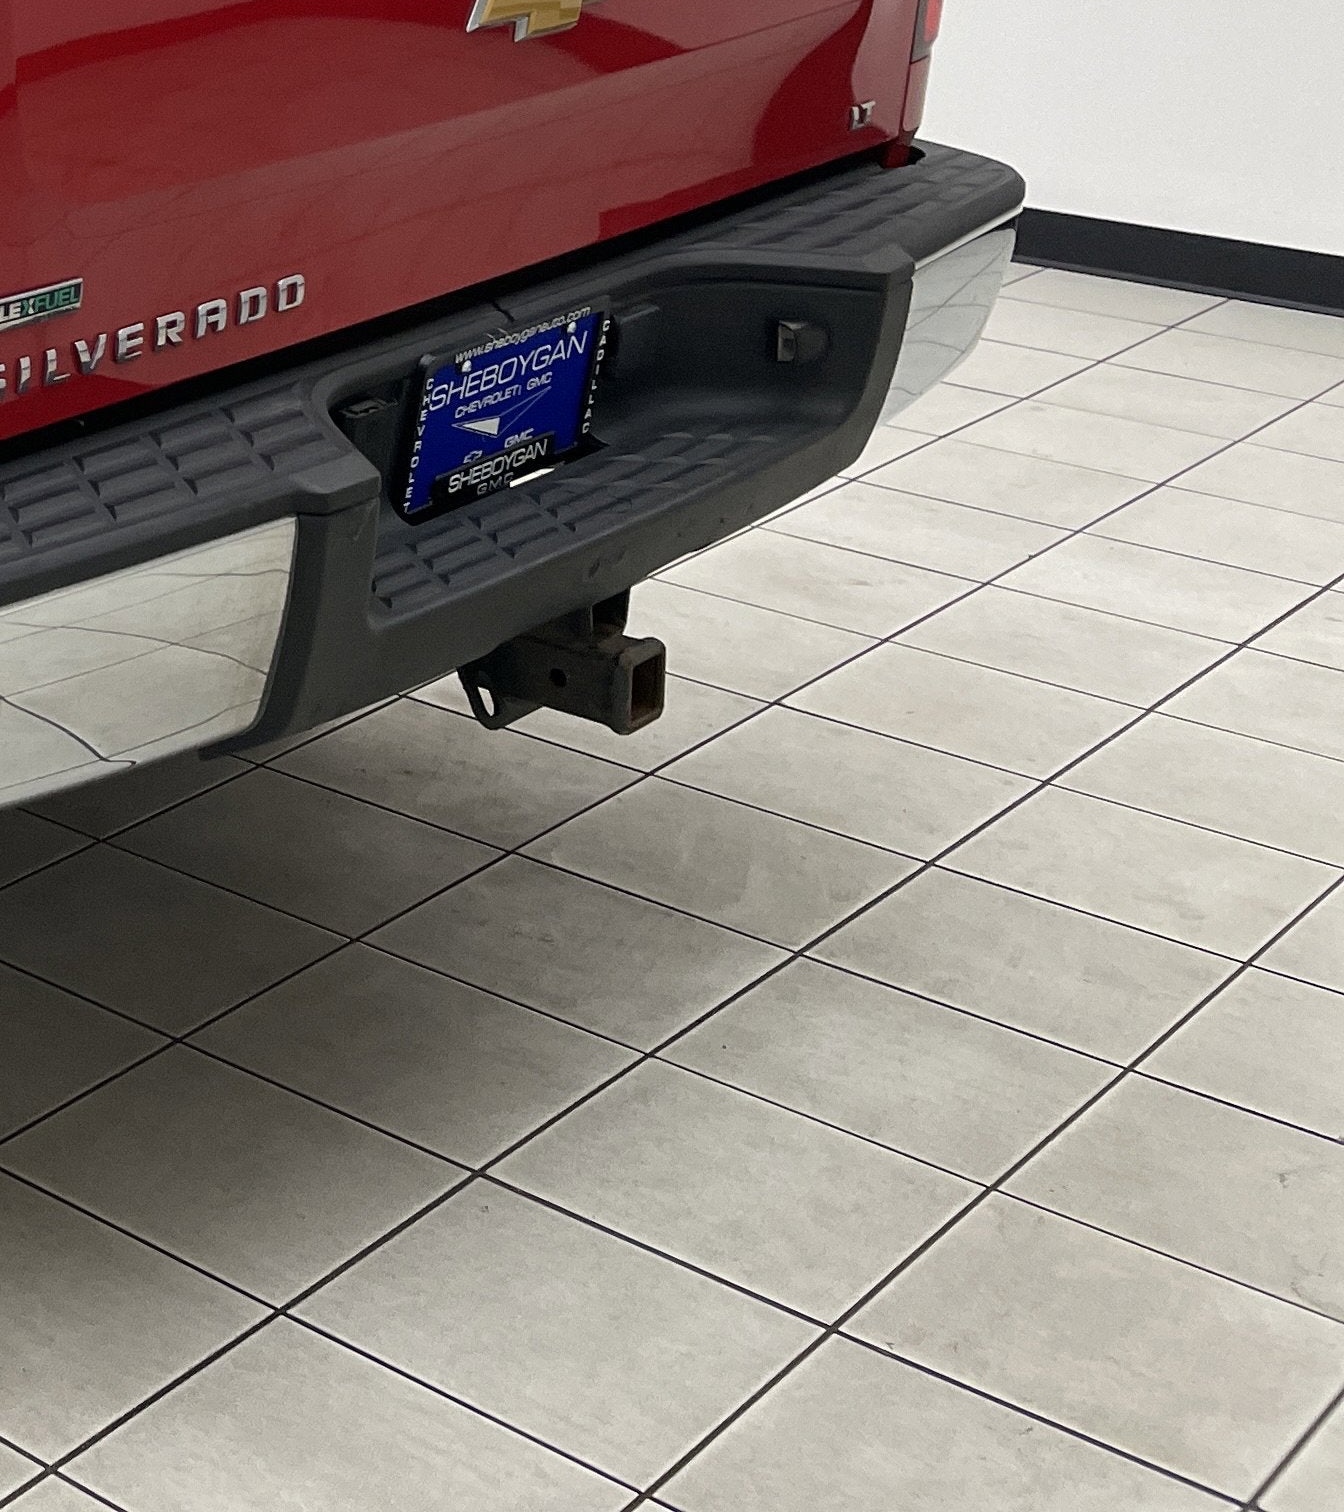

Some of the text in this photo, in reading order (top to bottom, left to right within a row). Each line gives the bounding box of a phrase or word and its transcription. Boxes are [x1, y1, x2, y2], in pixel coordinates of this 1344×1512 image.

[851, 100, 876, 130] LT
[429, 330, 589, 411] SHEBOYGAN
[526, 371, 553, 391] GMC
[581, 319, 611, 435] CADILLAC
[402, 378, 434, 514] CHEVROLET
[504, 427, 535, 449] GMC
[448, 438, 548, 494] SHEBOYGAN
[476, 471, 515, 496] GMC
